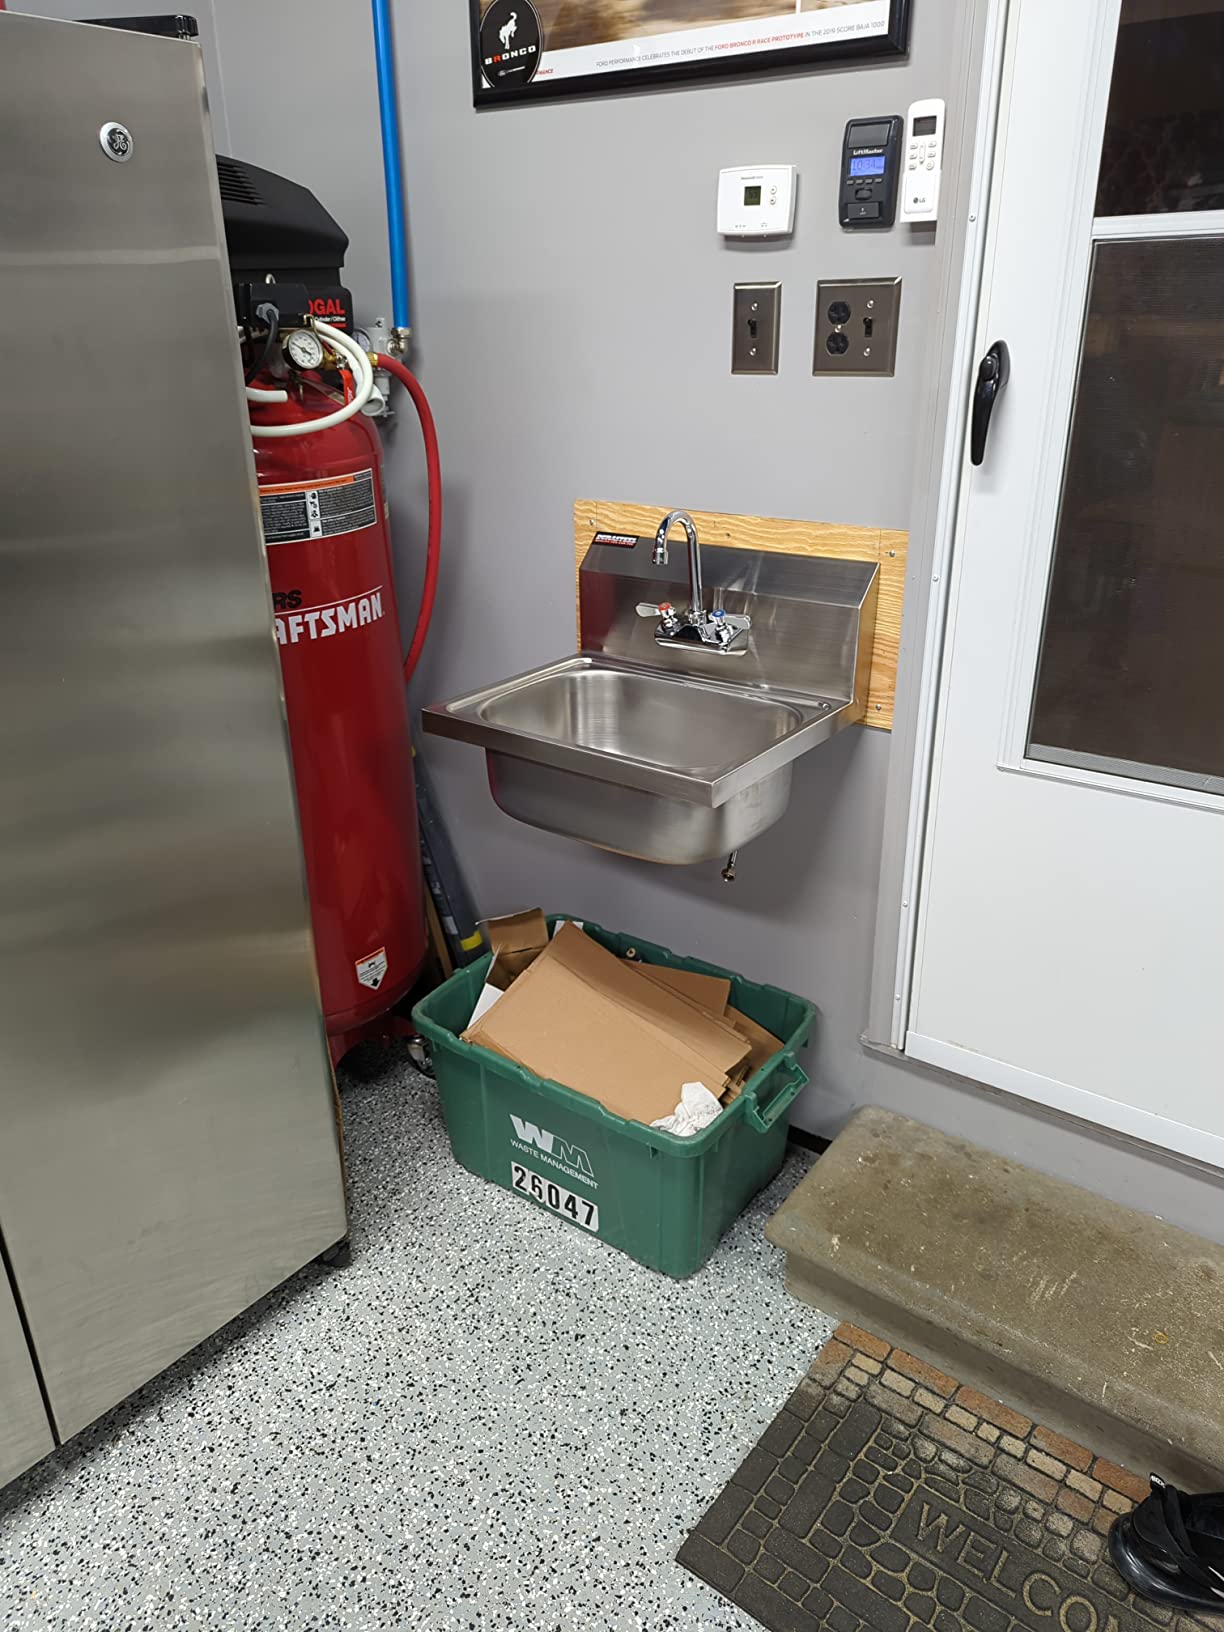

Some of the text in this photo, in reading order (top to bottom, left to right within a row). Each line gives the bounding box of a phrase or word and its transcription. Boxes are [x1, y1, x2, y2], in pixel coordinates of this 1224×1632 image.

[484, 45, 537, 65] BRONCO
[609, 56, 641, 65] PERFORMANCE
[641, 52, 670, 61] CELEBRATES
[729, 40, 752, 48] BRONCO
[757, 37, 771, 45] RACE
[772, 31, 804, 42] PROTOTYPE
[823, 27, 836, 35] 2019
[837, 25, 855, 33] SCORE
[856, 22, 870, 31] BAJA
[871, 20, 885, 28] 1000
[308, 298, 346, 315] GAL
[510, 1139, 599, 1190] WASTE MANAGEMENT
[513, 1165, 595, 1226] 26047
[916, 1502, 1119, 1632] WELCO
